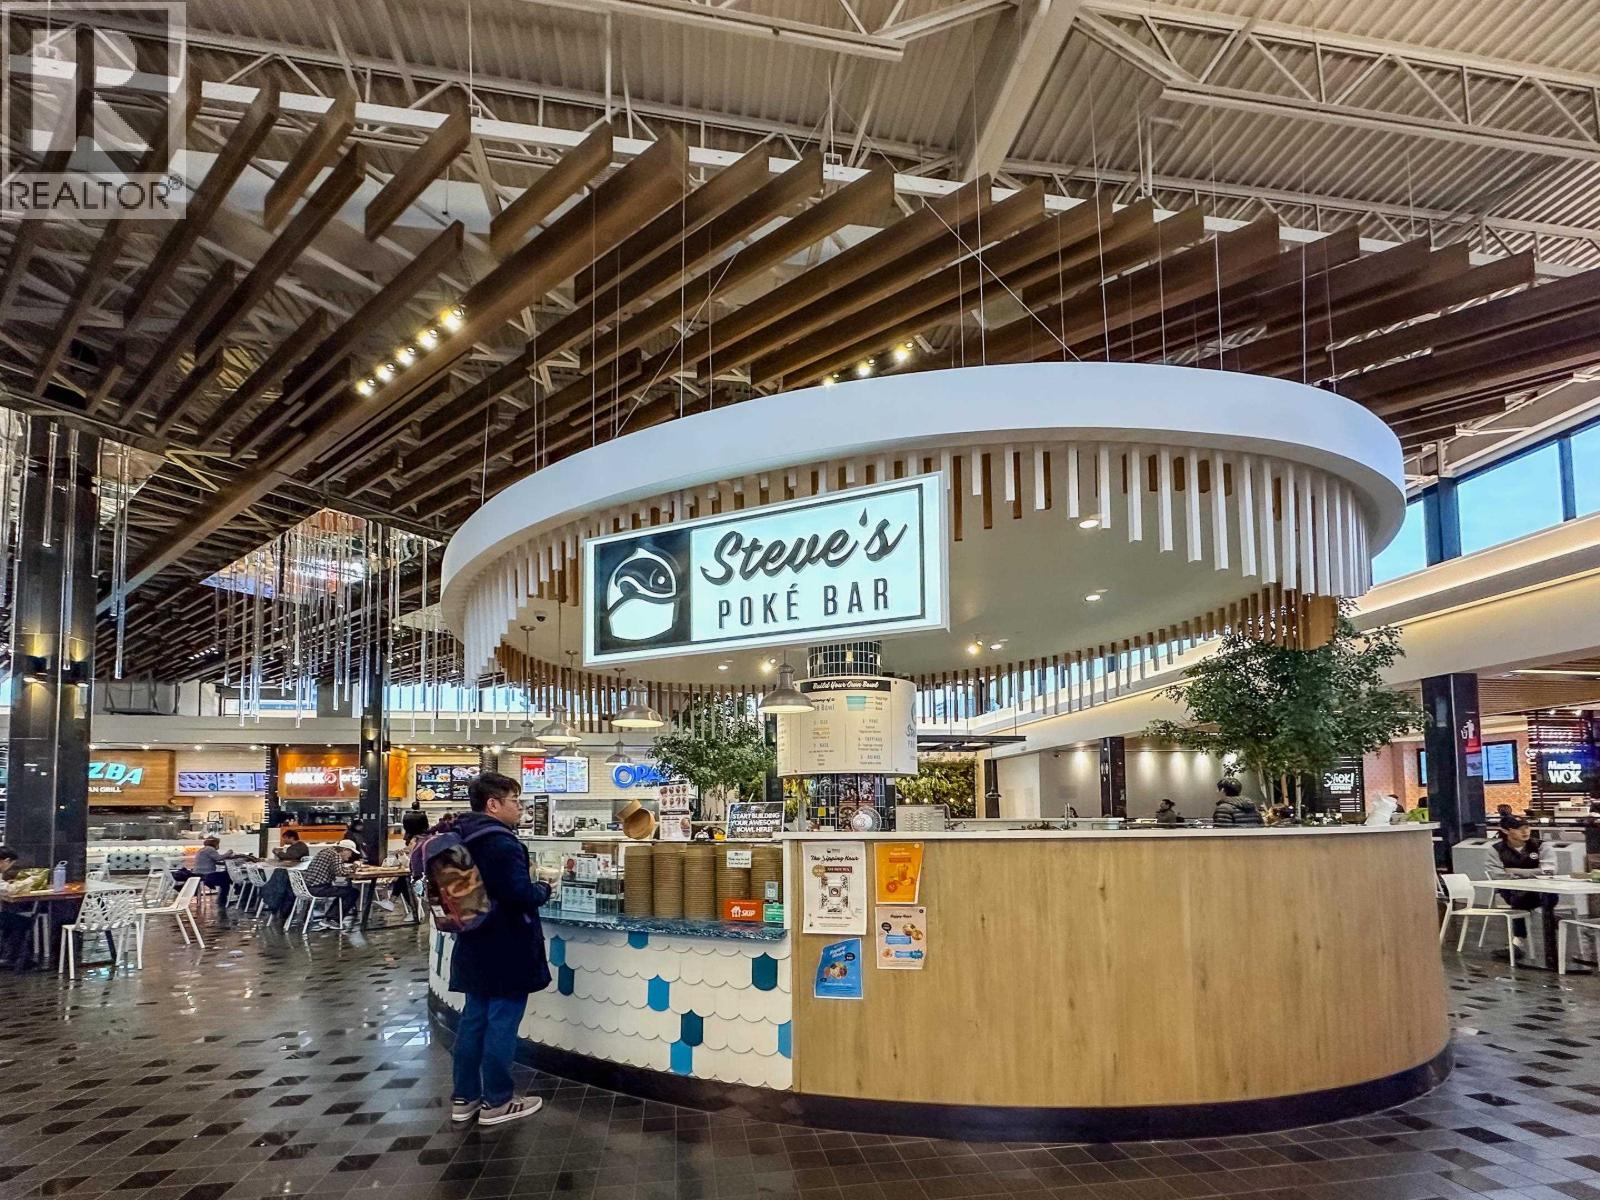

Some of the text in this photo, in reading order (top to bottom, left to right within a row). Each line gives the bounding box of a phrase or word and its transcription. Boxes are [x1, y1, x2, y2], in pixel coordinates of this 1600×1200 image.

[700, 507, 908, 585] Steve's
[718, 577, 889, 629] POKÉ BAR
[1547, 770, 1584, 784] WOK
[732, 812, 751, 820] START
[730, 819, 748, 827] YOUR
[740, 909, 756, 917] SKIP
